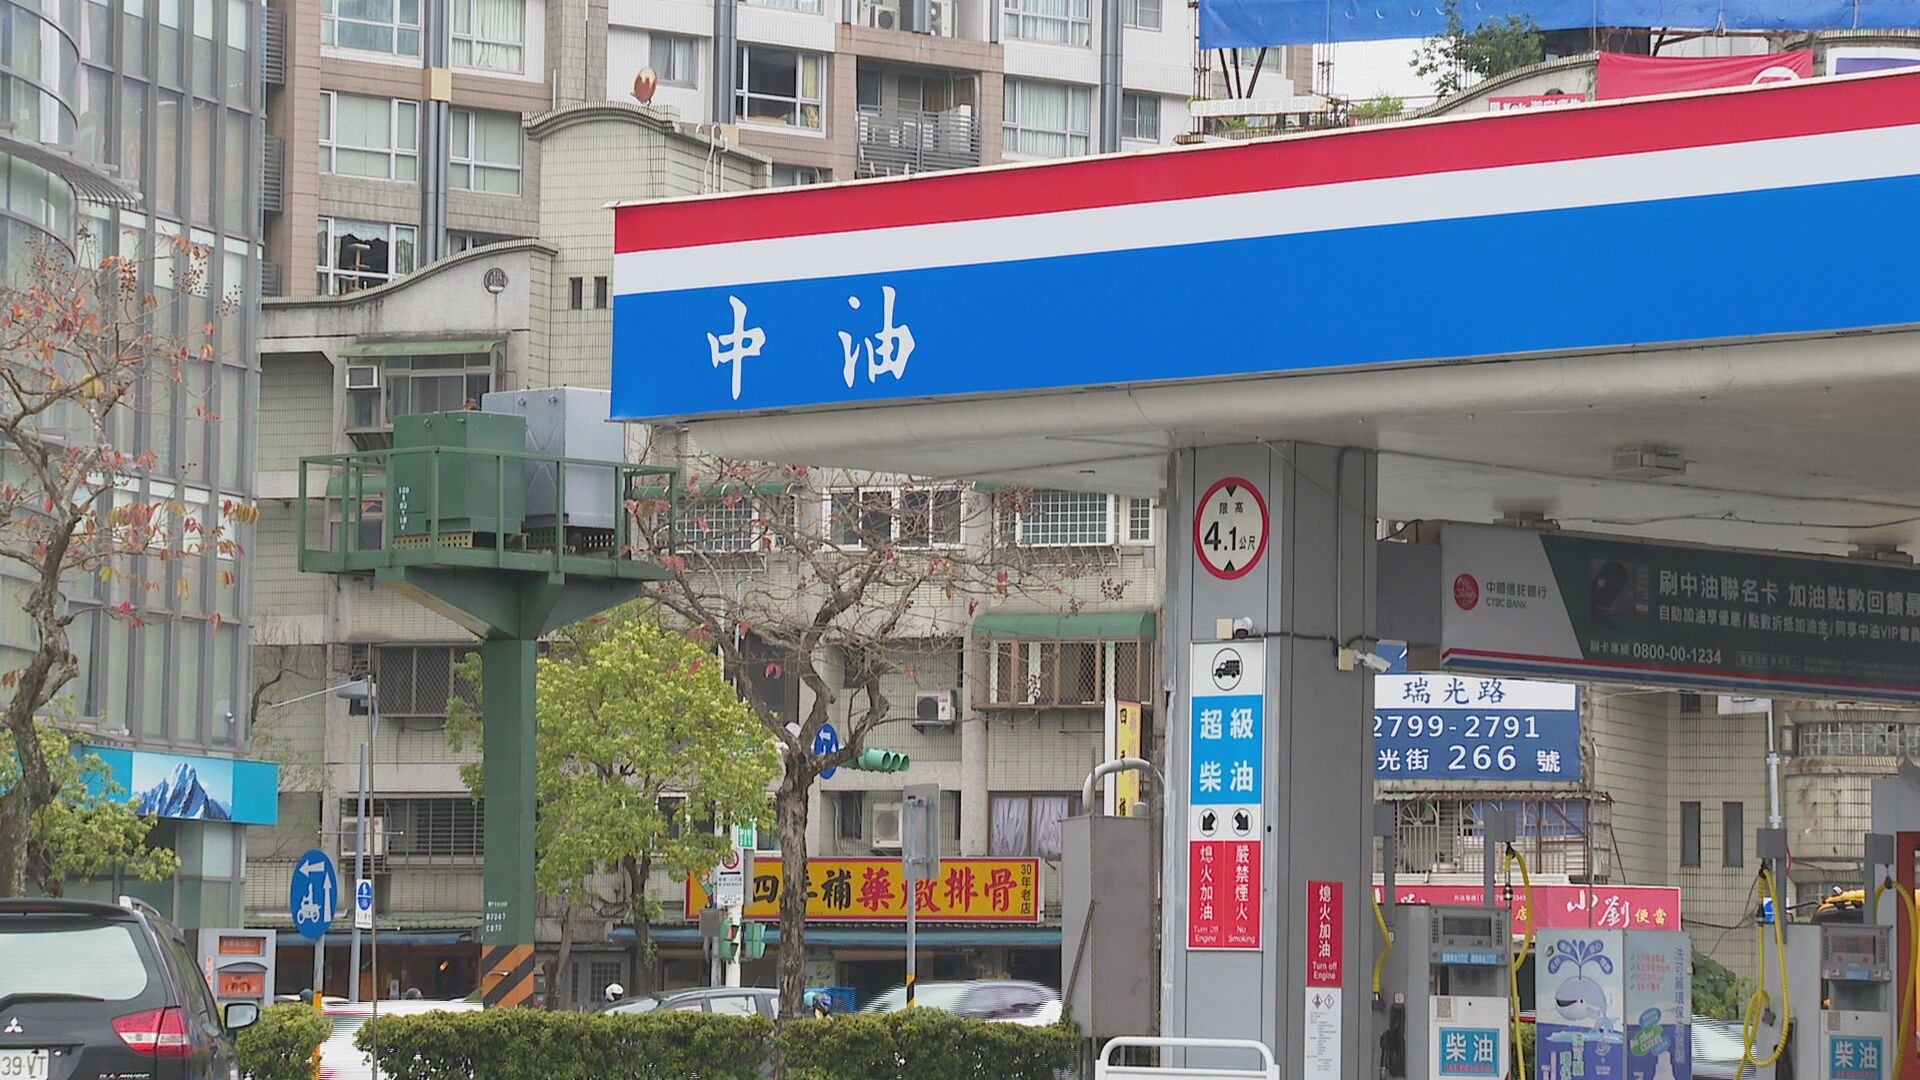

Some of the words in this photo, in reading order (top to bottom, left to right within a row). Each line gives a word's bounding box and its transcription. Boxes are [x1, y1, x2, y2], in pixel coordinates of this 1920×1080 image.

[707, 286, 915, 400] 中油
[1219, 502, 1244, 515] 限高
[1659, 569, 1778, 605] 刷中油聯名卡
[1633, 642, 1722, 664] 0800-00-1234
[1402, 677, 1507, 705] 瑞光路
[1200, 708, 1253, 740] 超級
[1377, 748, 1430, 772] 光街
[1448, 745, 1517, 771] 266
[1536, 750, 1561, 773] 號
[1200, 760, 1253, 793] 柴油
[753, 865, 1018, 913] 四補藥燉排骨
[1020, 863, 1032, 914] 30年老店
[1199, 844, 1214, 921] 熄火加油
[1234, 844, 1250, 921] 嚴禁煙火
[1318, 884, 1331, 958] 熄火加油
[1567, 888, 1630, 928] 小劉
[1635, 907, 1668, 926] 便當
[1195, 934, 1217, 944] Engine
[1228, 934, 1256, 945] Smoking
[1237, 925, 1247, 934] No
[1313, 961, 1327, 971] Turn
[1313, 971, 1336, 981] Engine
[1445, 1032, 1494, 1063] 柴油
[1834, 1040, 1878, 1069] 柴油
